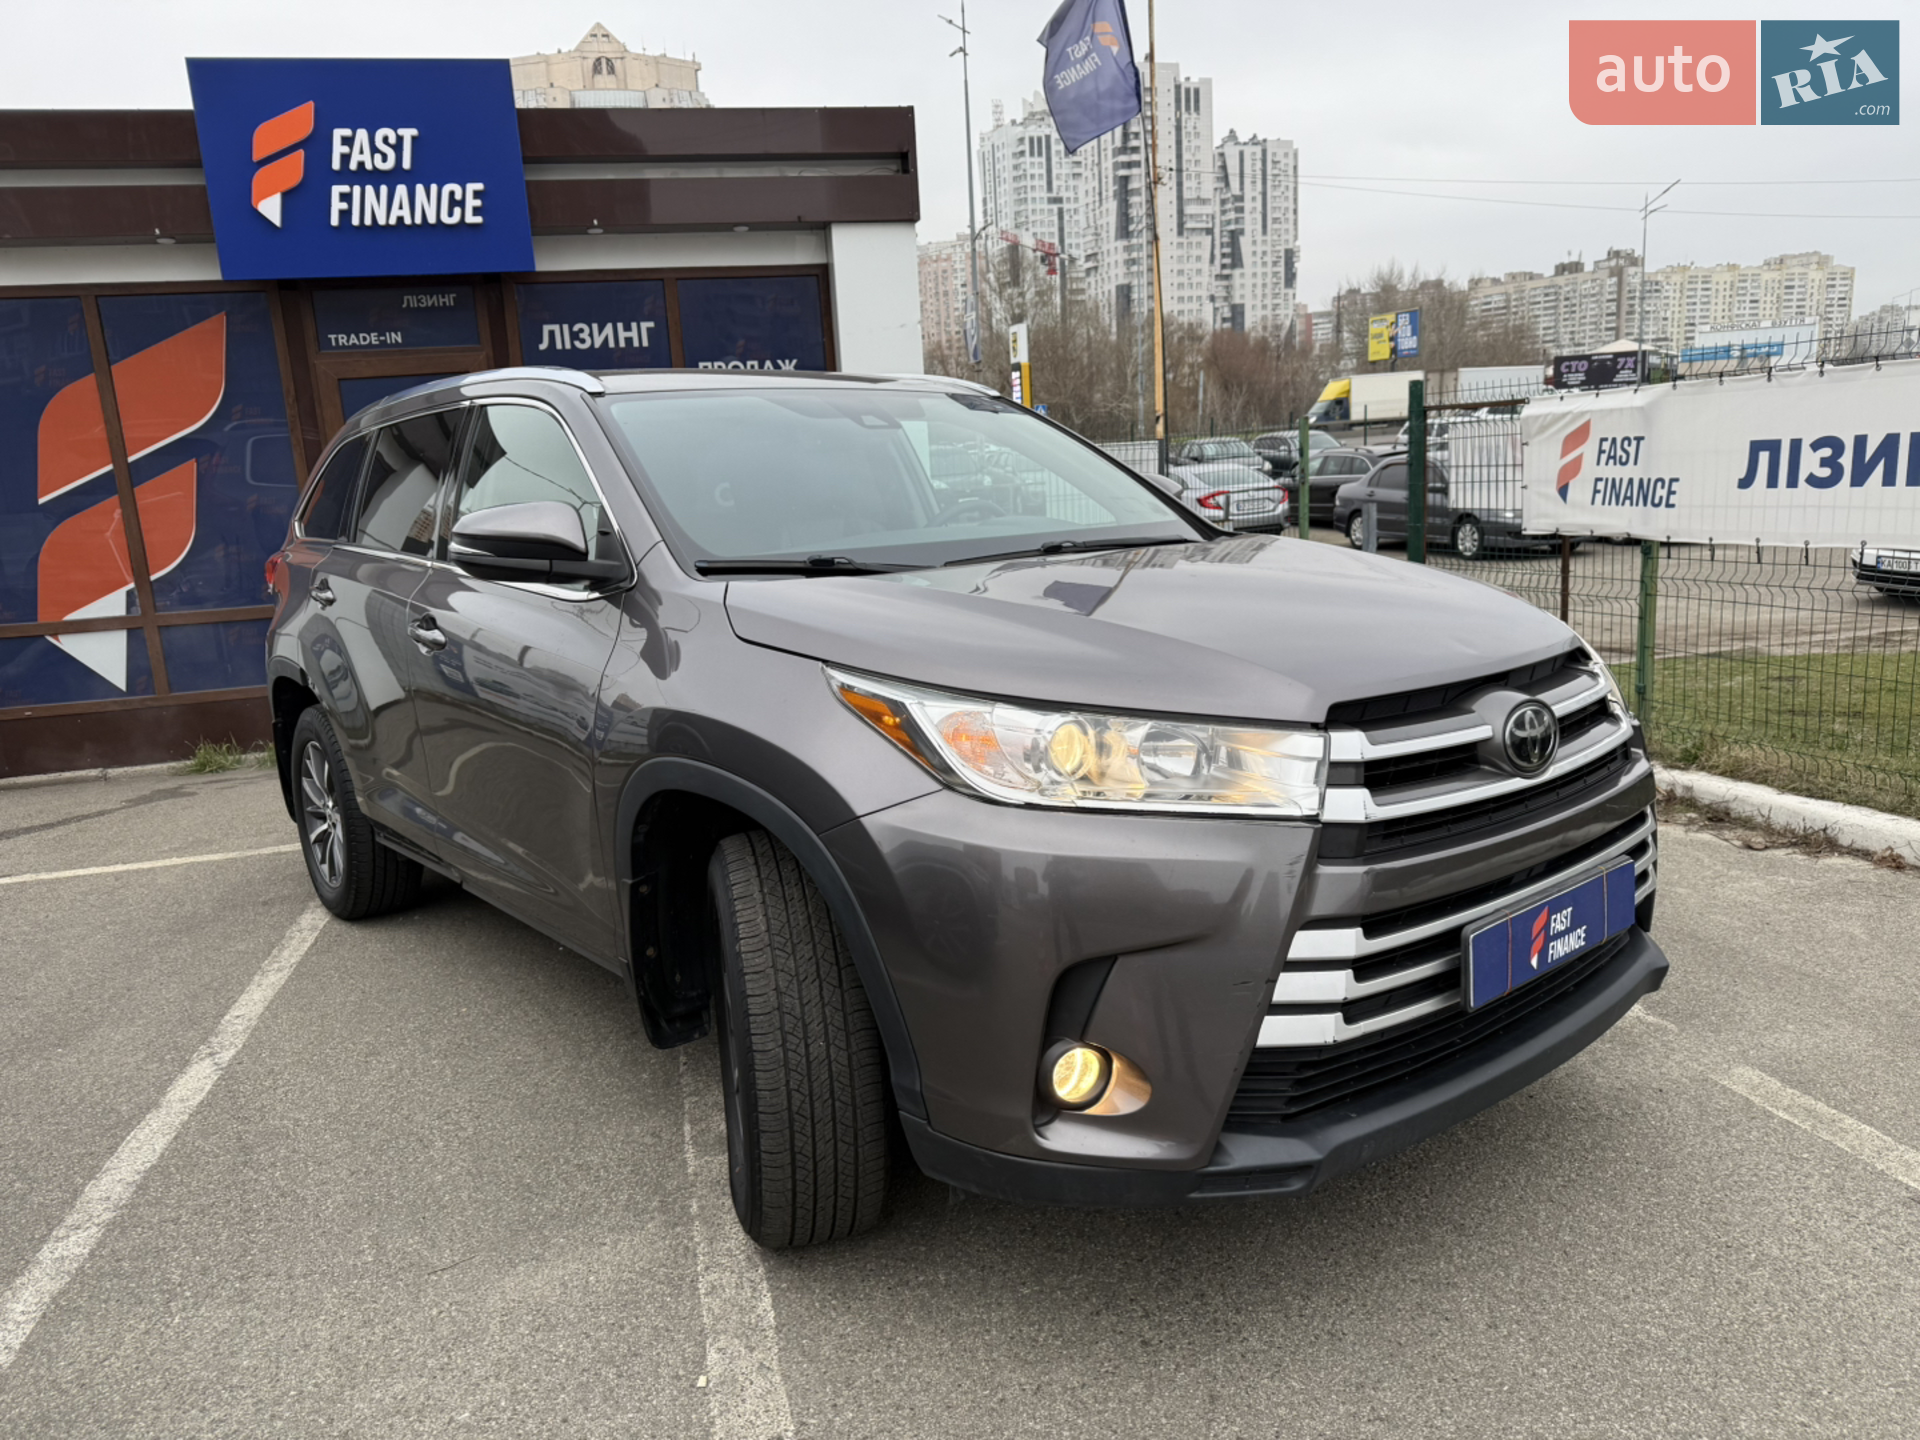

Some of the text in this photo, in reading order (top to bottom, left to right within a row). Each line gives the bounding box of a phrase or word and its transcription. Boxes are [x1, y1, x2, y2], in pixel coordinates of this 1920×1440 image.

[331, 127, 419, 171] FAST
[330, 182, 485, 227] FINANCE
[402, 294, 457, 308] ЛІЗИНГ
[328, 331, 403, 347] TRADE-IN
[538, 321, 655, 350] ЛІЗИНГ
[1596, 436, 1645, 466] FAST
[1591, 477, 1680, 508] FINANCE
[1550, 906, 1573, 936] FAST
[1547, 925, 1587, 963] FINANCE
